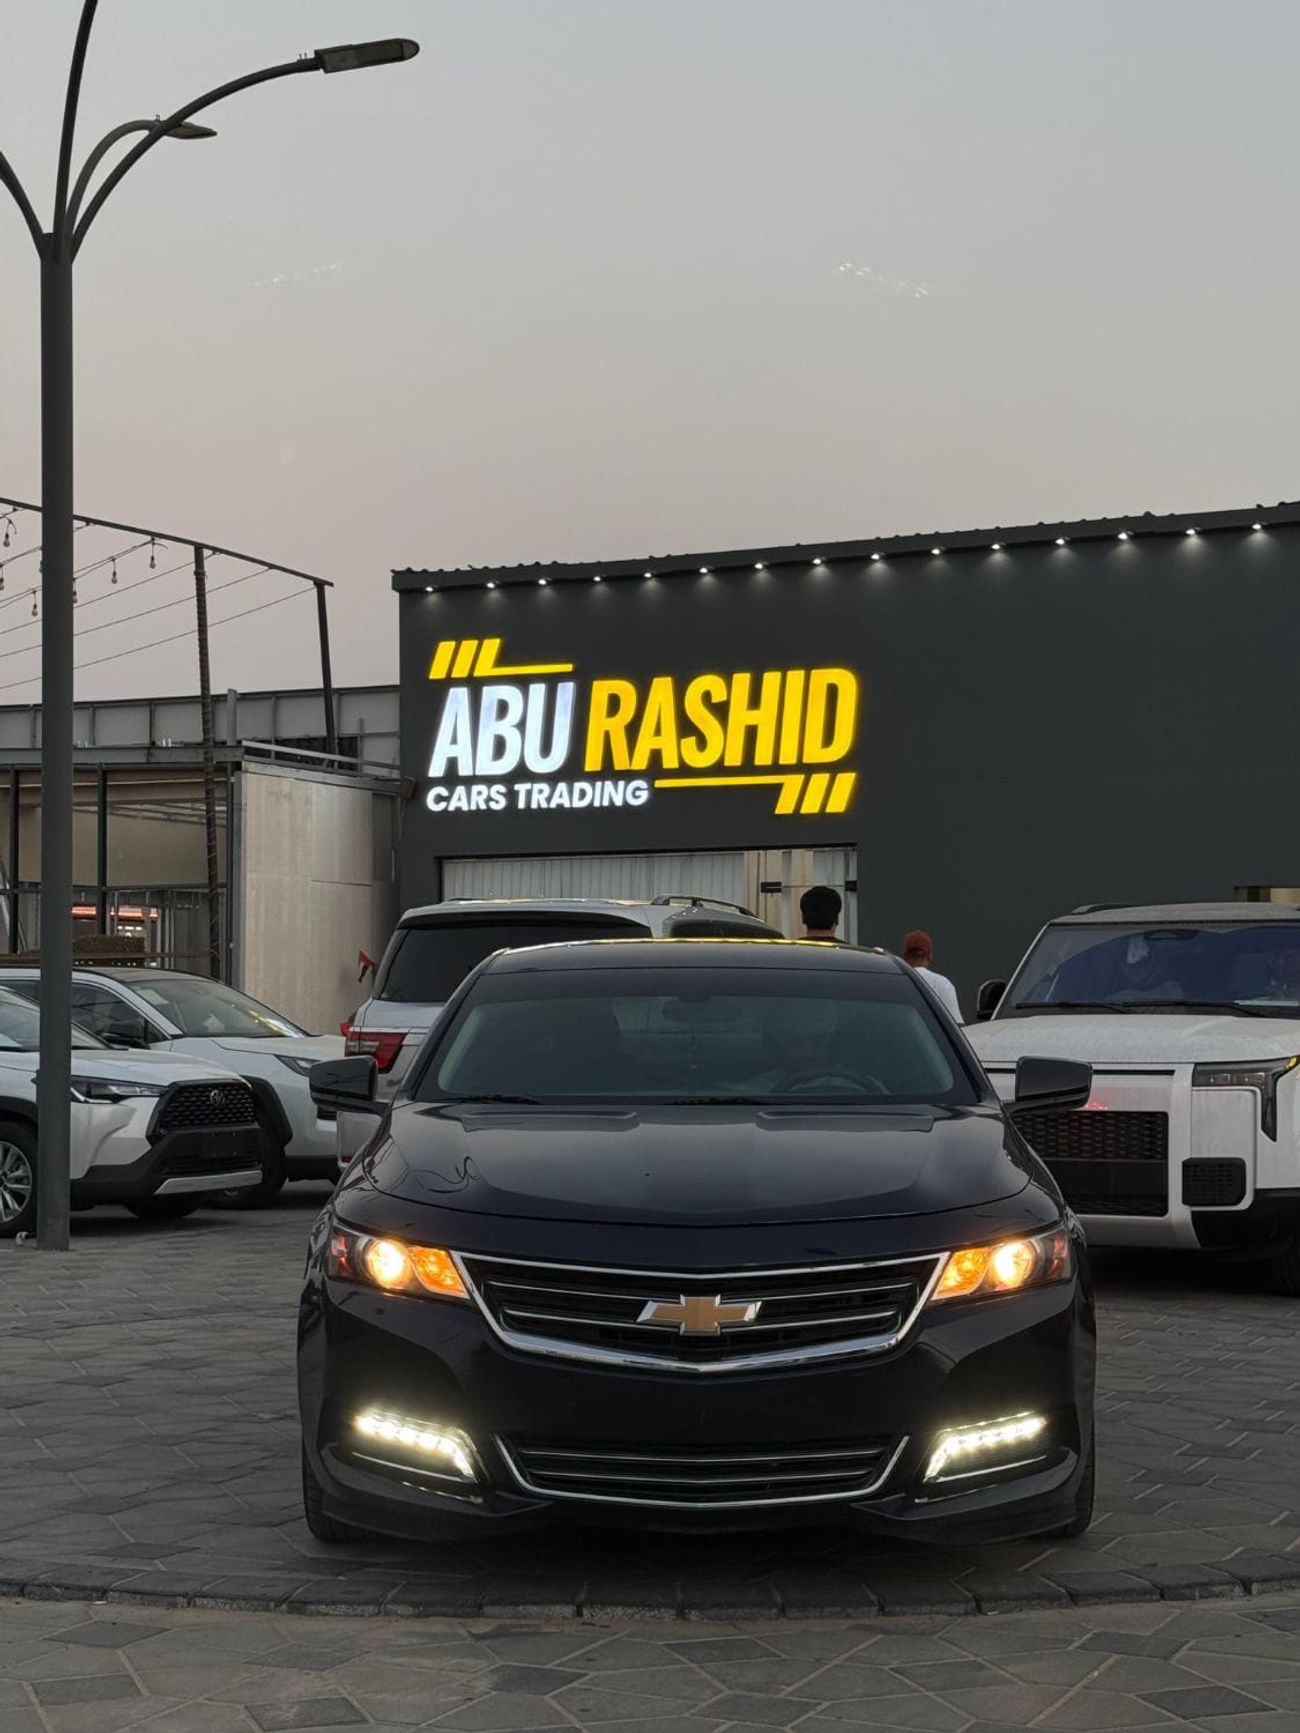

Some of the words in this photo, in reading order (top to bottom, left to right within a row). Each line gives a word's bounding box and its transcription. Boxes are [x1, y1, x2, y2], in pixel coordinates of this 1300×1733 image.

[428, 681, 574, 777] ABU
[584, 668, 857, 772] RASHID
[426, 784, 506, 812] CARS
[514, 780, 649, 809] TRADING
